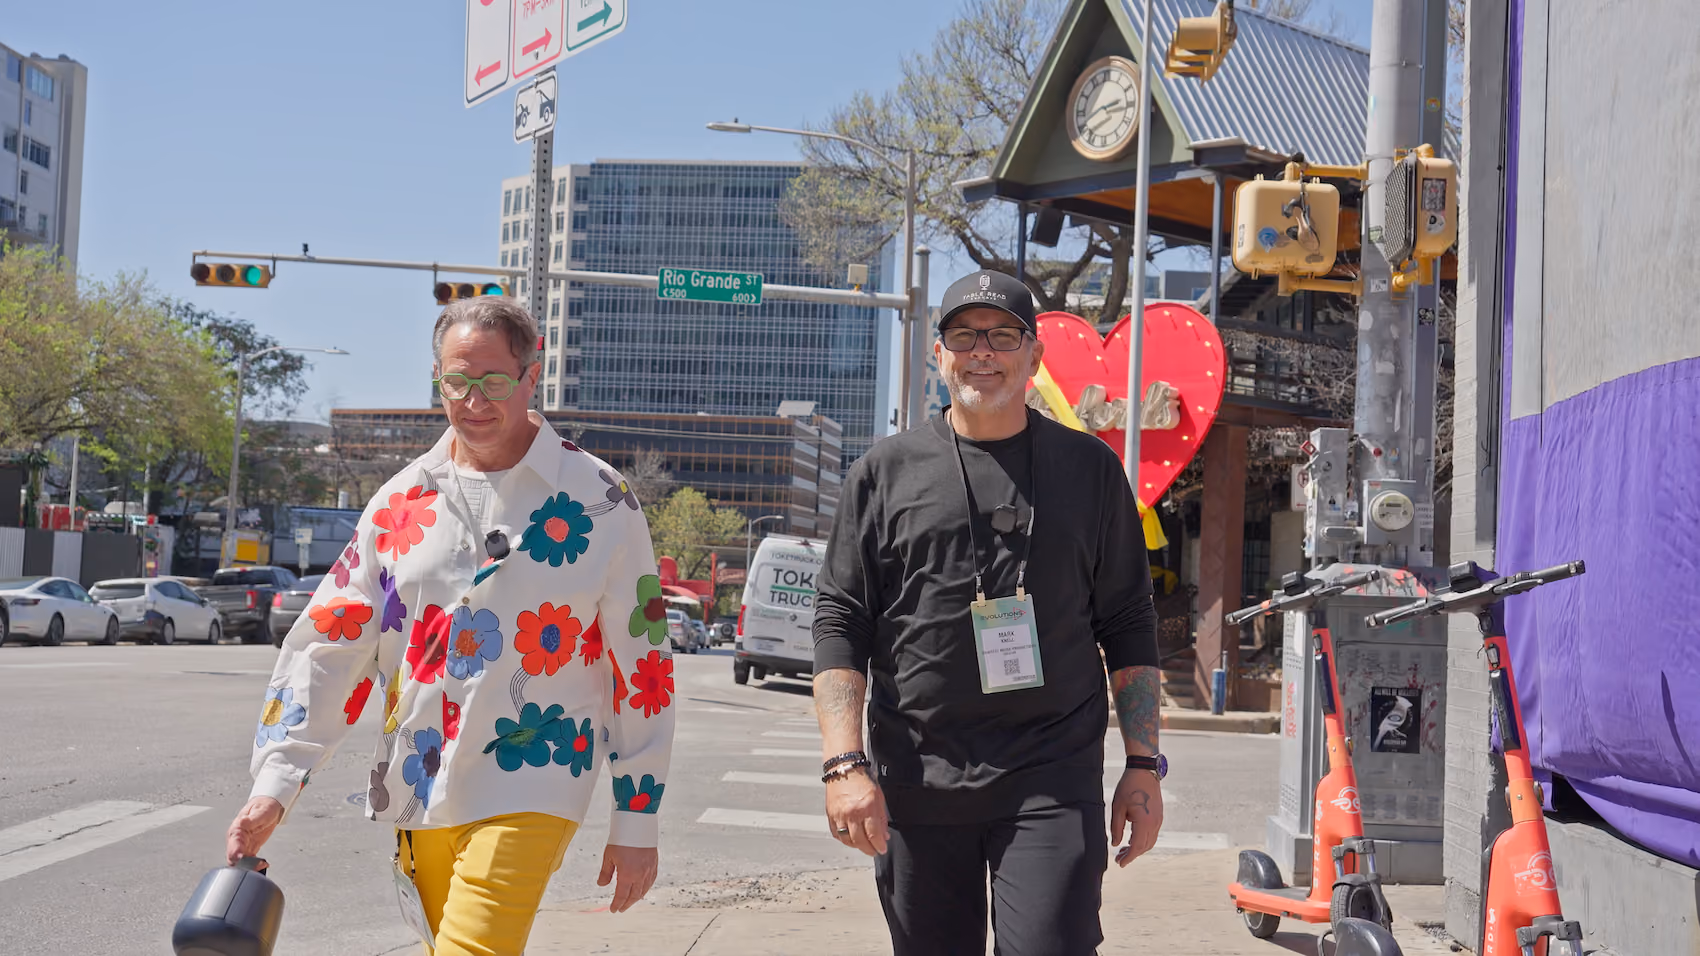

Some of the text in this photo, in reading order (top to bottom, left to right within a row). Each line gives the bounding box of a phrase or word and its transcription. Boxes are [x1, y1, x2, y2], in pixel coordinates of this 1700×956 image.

[663, 269, 758, 290] Rio Grande ST
[669, 288, 750, 303] 500 600
[987, 291, 1007, 300] READ
[773, 567, 818, 590] TOK
